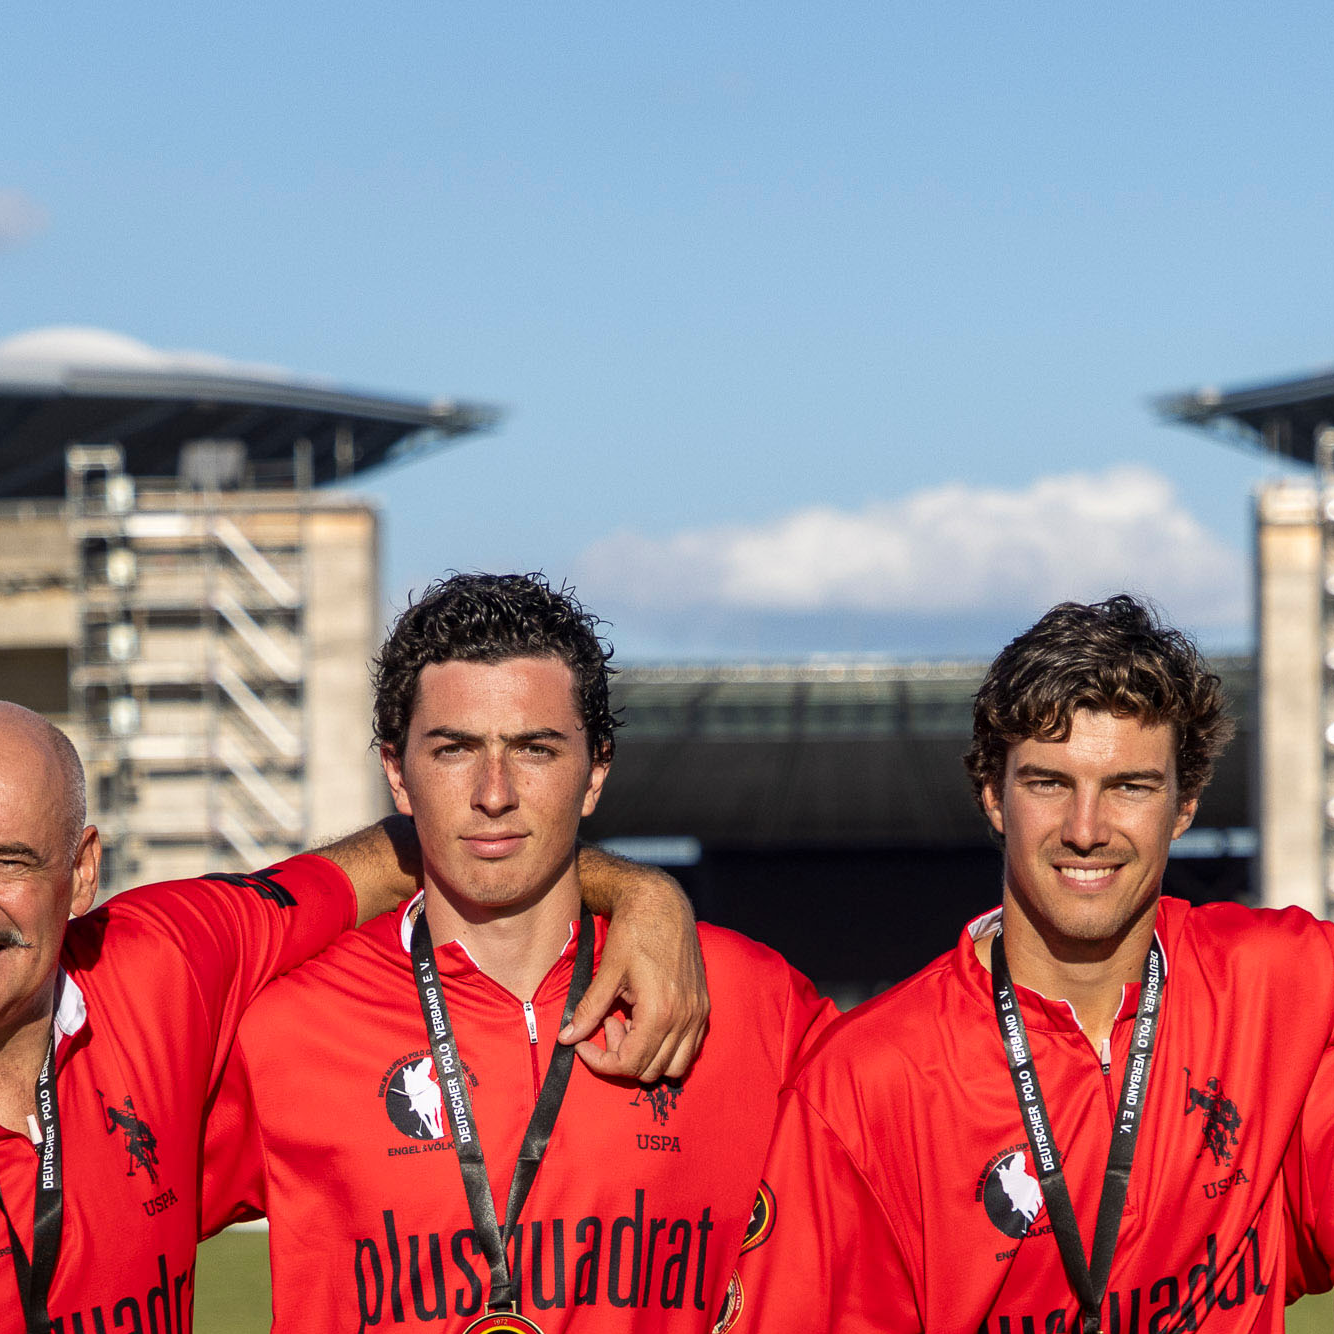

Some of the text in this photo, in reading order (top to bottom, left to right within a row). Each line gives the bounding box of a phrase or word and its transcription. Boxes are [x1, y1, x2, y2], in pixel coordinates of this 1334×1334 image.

[1144, 950, 1159, 1013] DEUTSCHER
[426, 987, 447, 1040] VERBAND
[1137, 1018, 1152, 1048] POLO
[408, 1050, 425, 1059] POLO
[439, 1043, 455, 1074] POLO
[1005, 1015, 1026, 1066] VERBAND
[1019, 1070, 1036, 1101] POLO
[1126, 1053, 1146, 1106] VERBAND
[40, 1090, 52, 1120] POLO
[447, 1077, 472, 1143] DEUTSCHER
[43, 1124, 55, 1189] DEUTSCHER
[636, 1133, 682, 1153] USPA
[1028, 1105, 1055, 1172] DEUTSCHER
[142, 1188, 178, 1218] USPA
